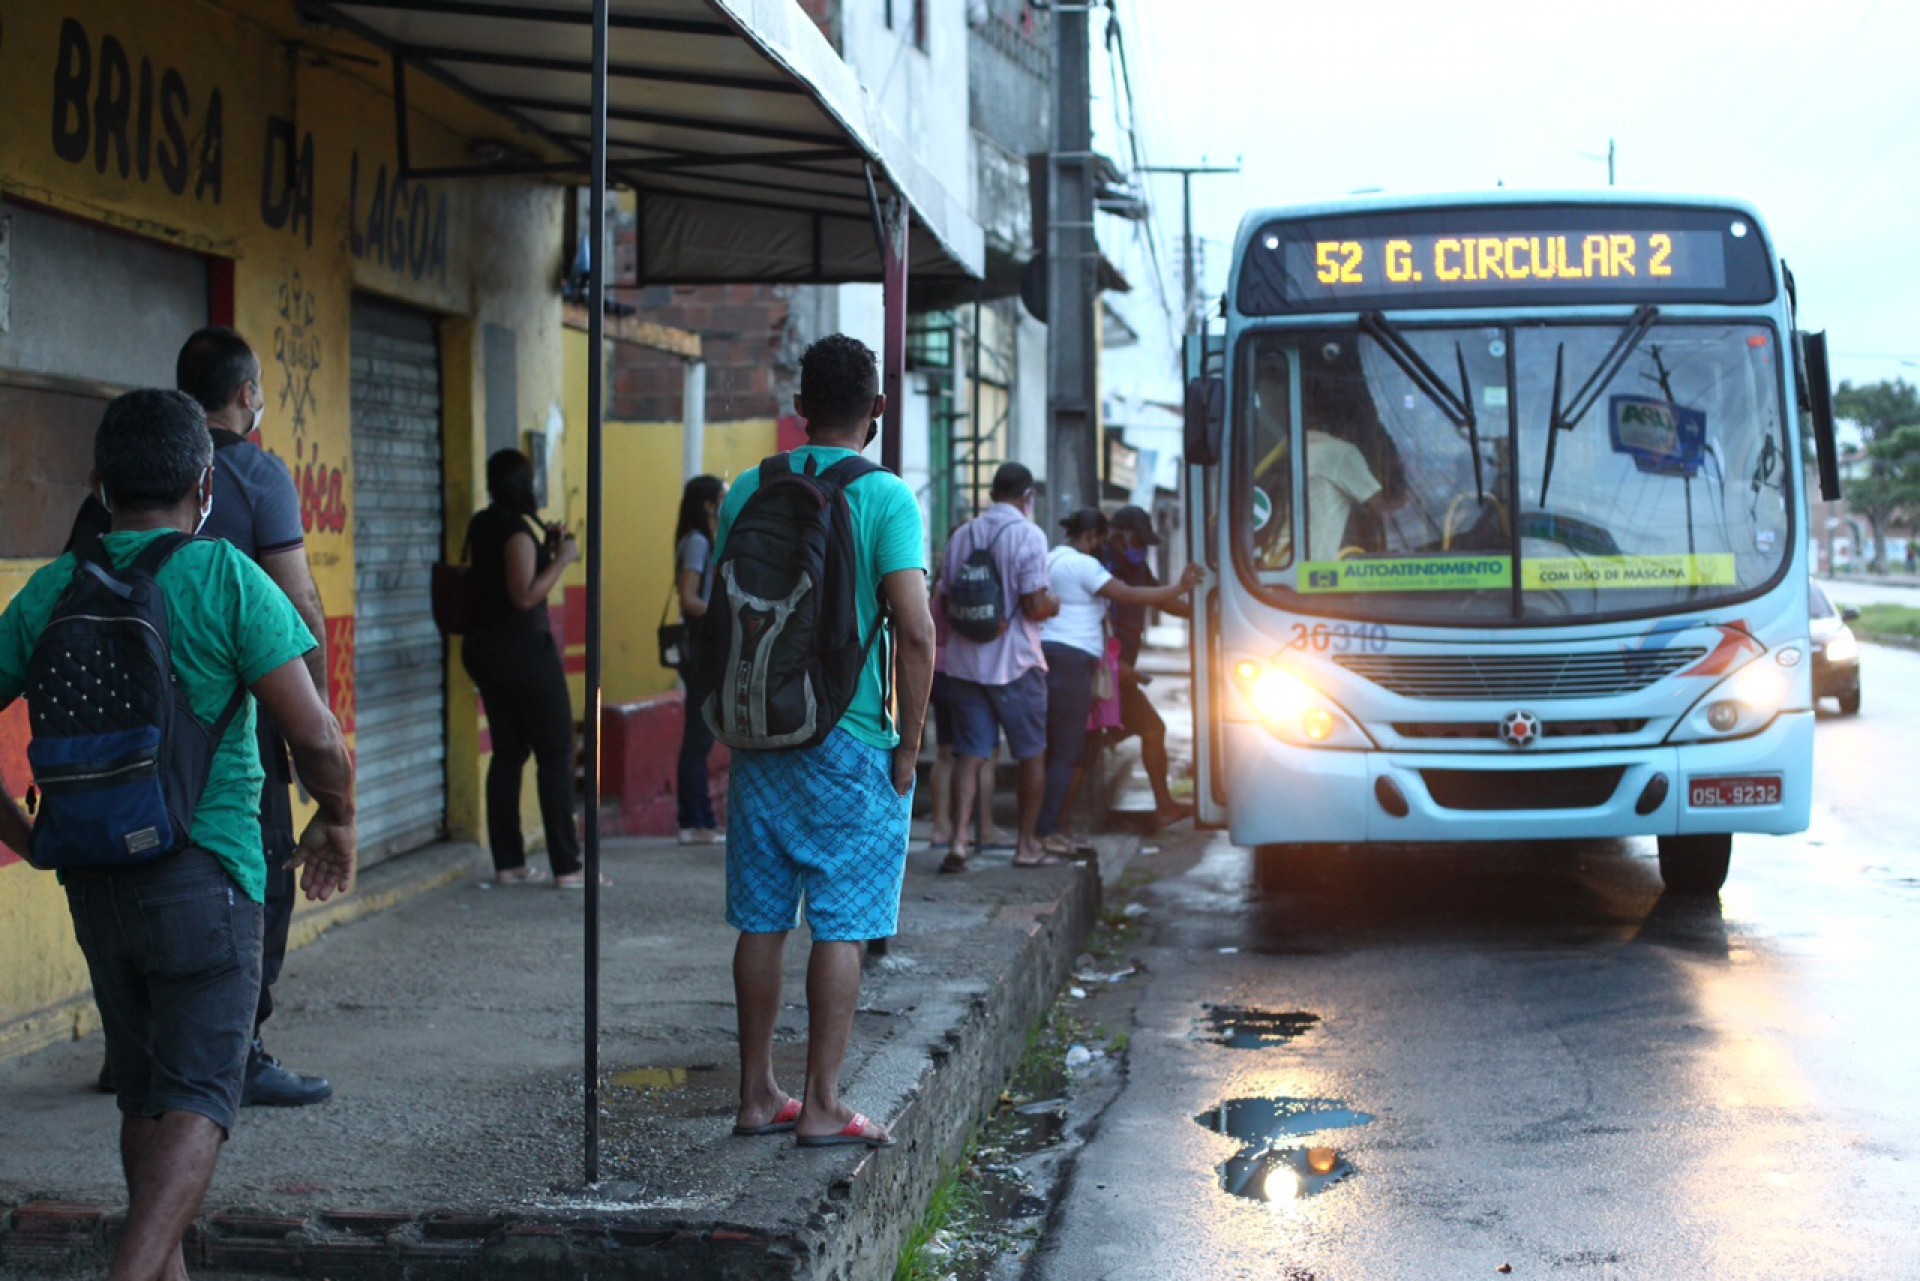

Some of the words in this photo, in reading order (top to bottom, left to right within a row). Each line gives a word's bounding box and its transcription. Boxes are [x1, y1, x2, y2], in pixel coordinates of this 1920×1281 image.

[52, 17, 222, 205] BRISA
[261, 114, 314, 250] DA
[350, 149, 447, 286] LAGOA
[1316, 241, 1363, 283] 52
[1385, 240, 1422, 282] G.
[1434, 235, 1636, 280] CIRCULAR
[1649, 234, 1672, 276] 2
[1345, 561, 1502, 577] AUTOATENDIMENTO
[1539, 571, 1570, 583] COM
[1574, 570, 1600, 582] USO
[1604, 569, 1620, 580] DE
